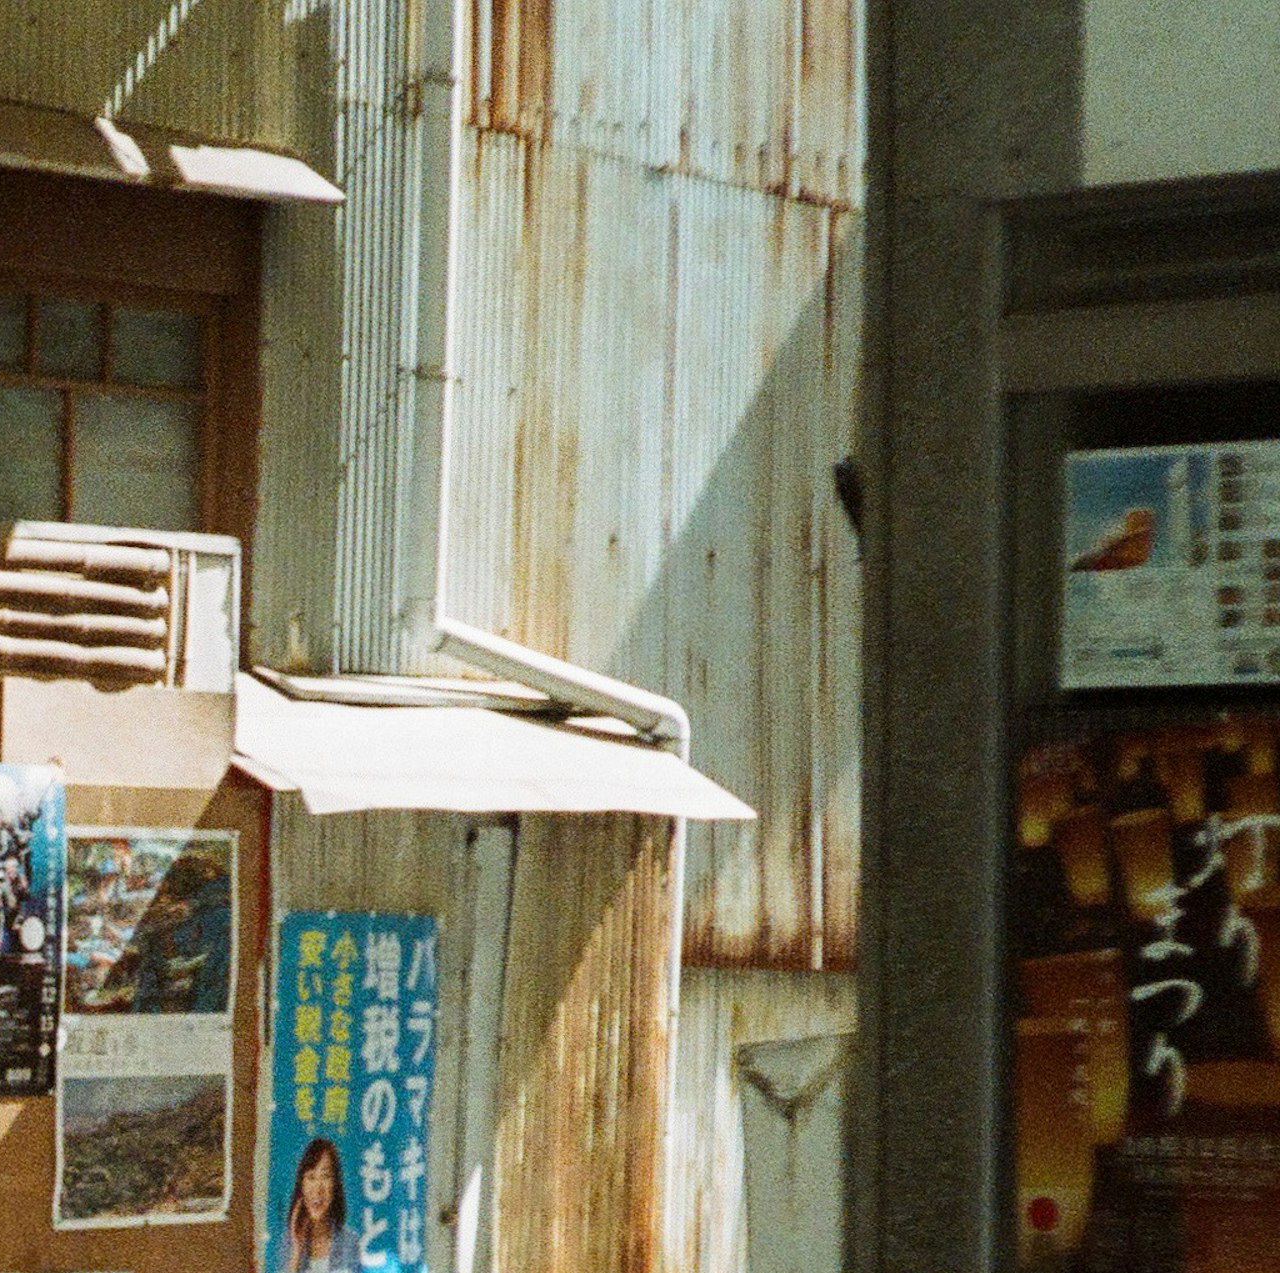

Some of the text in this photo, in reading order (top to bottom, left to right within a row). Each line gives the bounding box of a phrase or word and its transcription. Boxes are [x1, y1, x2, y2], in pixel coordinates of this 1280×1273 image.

[357, 930, 403, 1268] 増税のもと
[1130, 884, 1208, 1118] まつり
